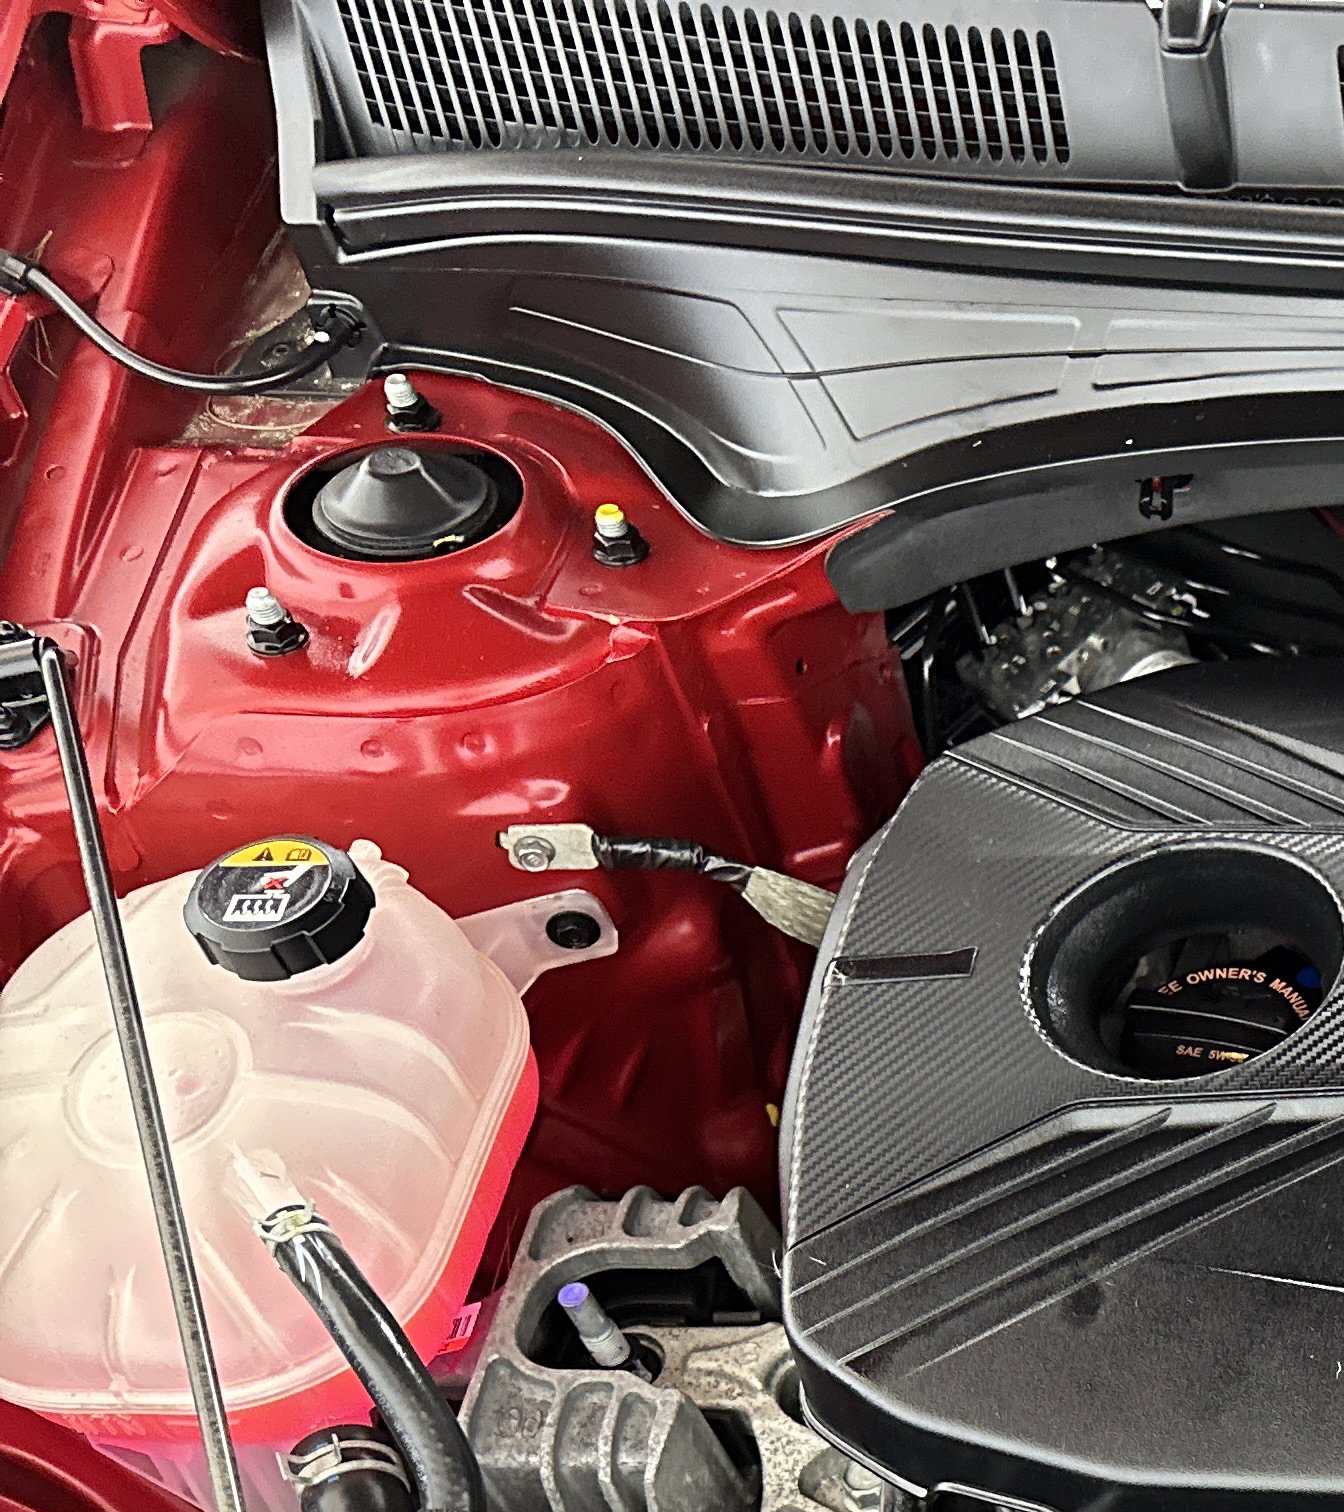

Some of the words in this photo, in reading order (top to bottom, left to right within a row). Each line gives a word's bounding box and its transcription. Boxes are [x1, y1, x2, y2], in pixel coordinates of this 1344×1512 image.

[1186, 967, 1268, 986] OWNER'S
[1268, 977, 1311, 1022] MANUA
[1176, 1044, 1204, 1058] SAE
